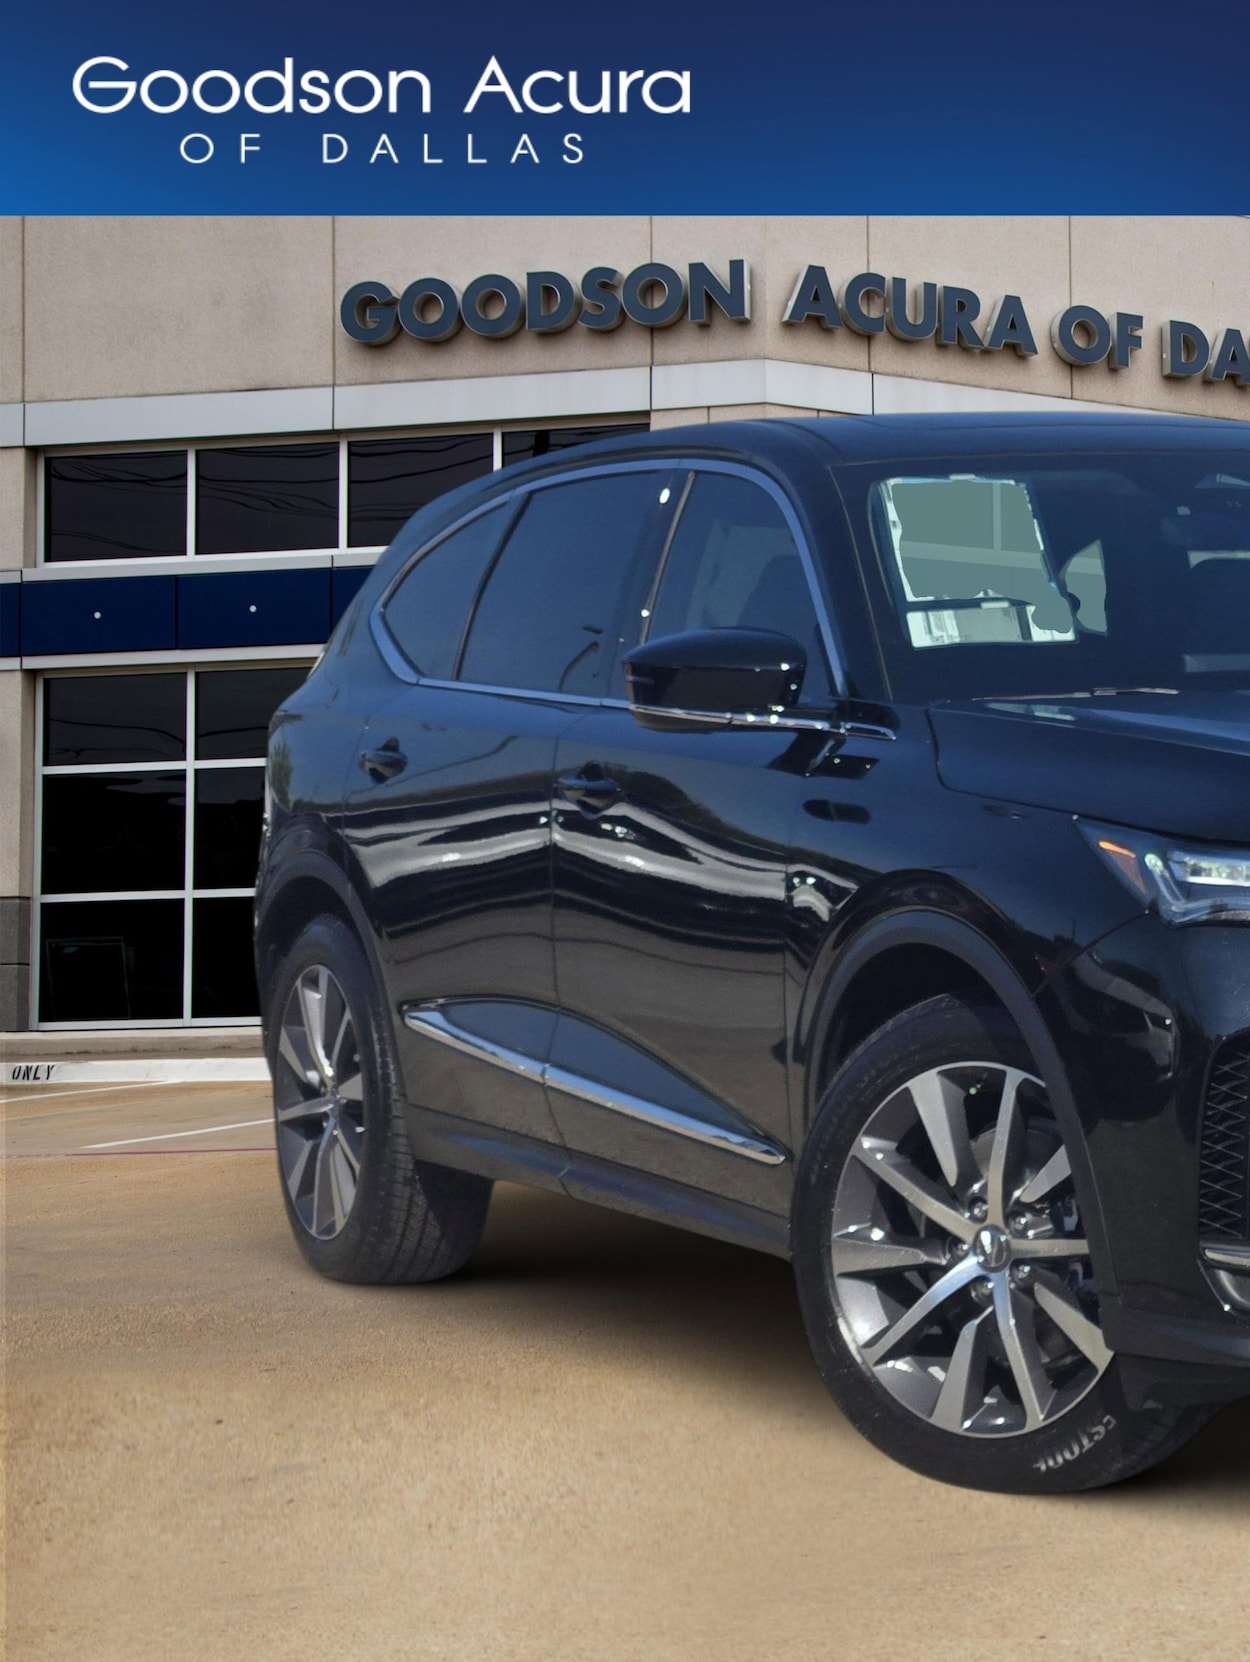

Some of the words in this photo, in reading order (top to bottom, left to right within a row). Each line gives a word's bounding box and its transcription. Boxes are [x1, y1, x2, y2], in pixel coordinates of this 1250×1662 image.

[340, 258, 751, 347] GOODSON
[782, 264, 1039, 357] ACURA
[1051, 304, 1144, 370] OF
[12, 1064, 56, 1081] ONLY
